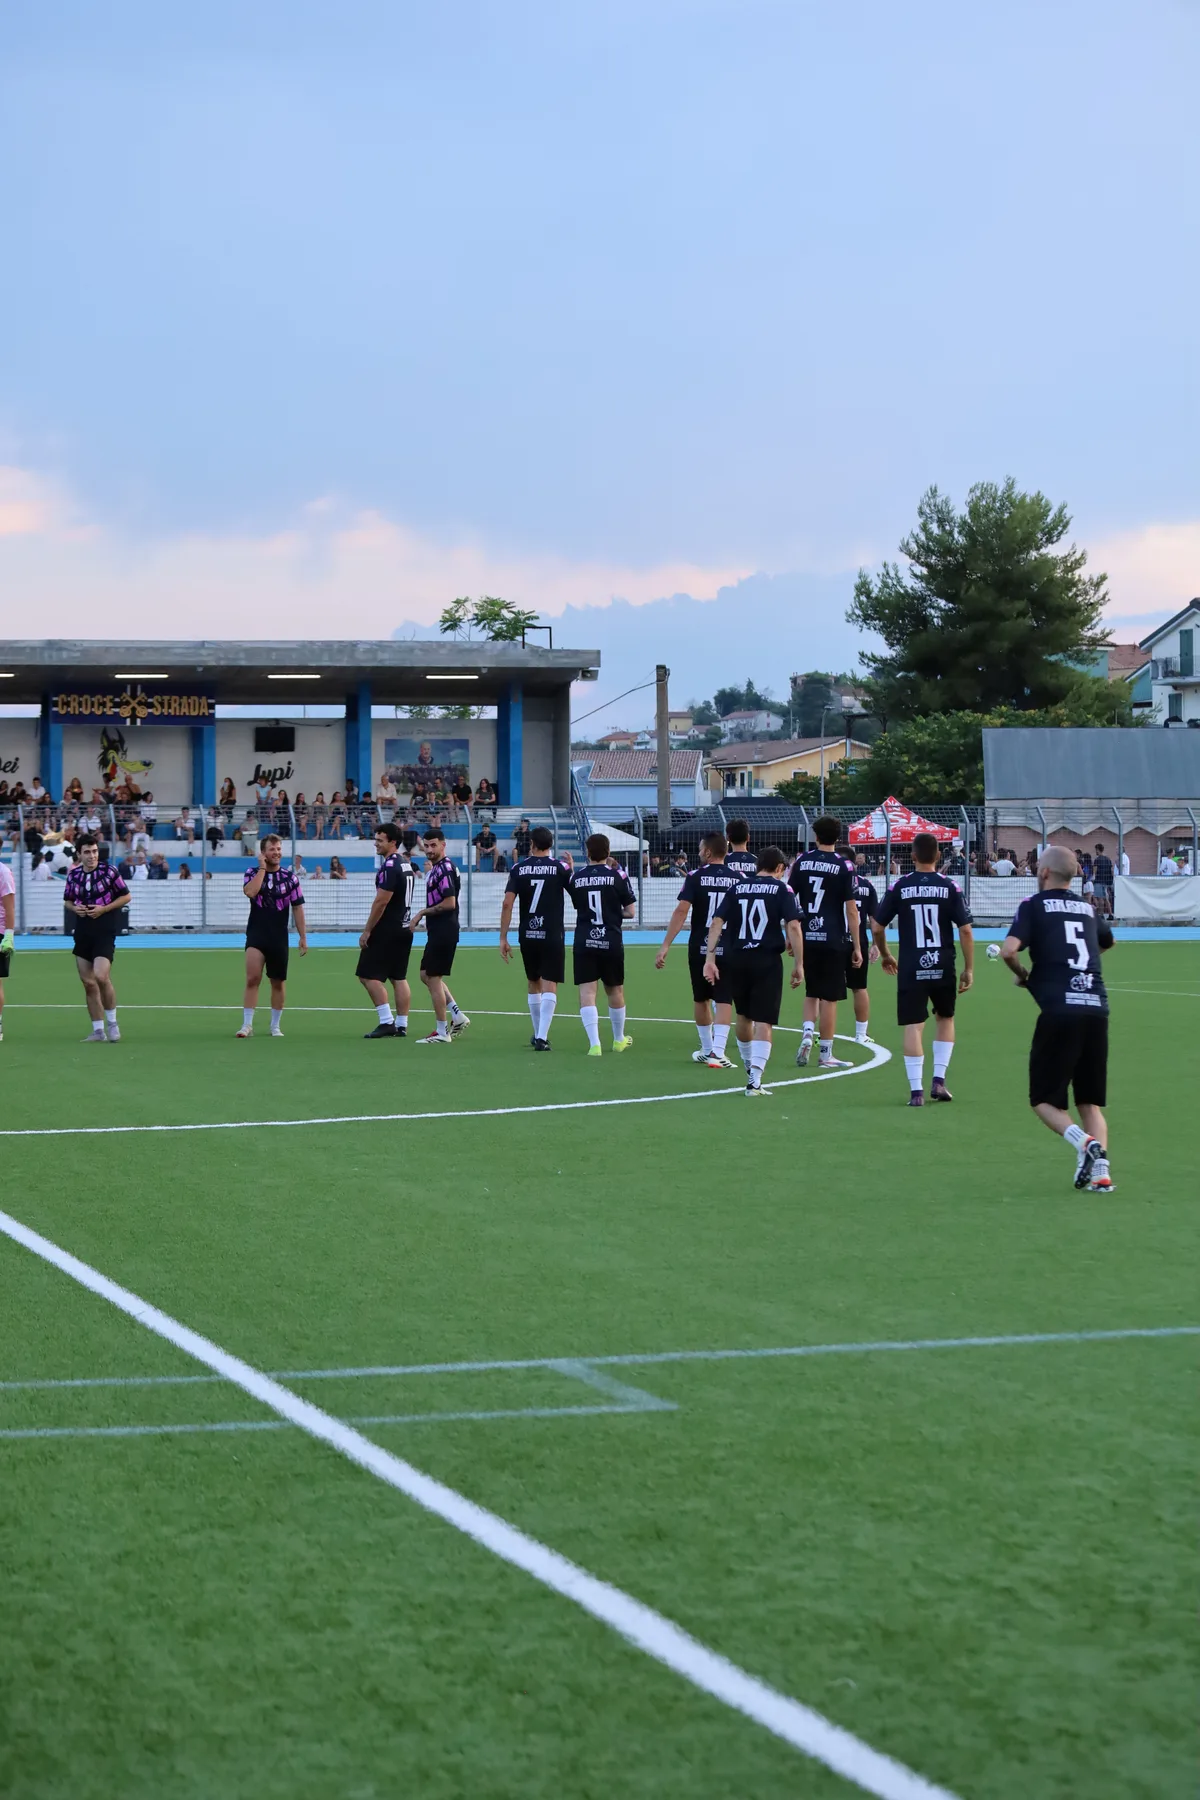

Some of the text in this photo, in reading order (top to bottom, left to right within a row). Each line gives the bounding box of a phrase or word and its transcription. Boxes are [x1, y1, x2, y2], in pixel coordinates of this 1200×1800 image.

[57, 694, 209, 716] CROCE STRADA
[0, 757, 19, 773] ei
[728, 861, 757, 872] SCALASAN
[529, 880, 545, 913] 7
[588, 891, 604, 925] 9
[808, 876, 825, 913] 3
[739, 899, 769, 940] 10
[911, 904, 941, 948] 19
[1064, 921, 1090, 971] 5
